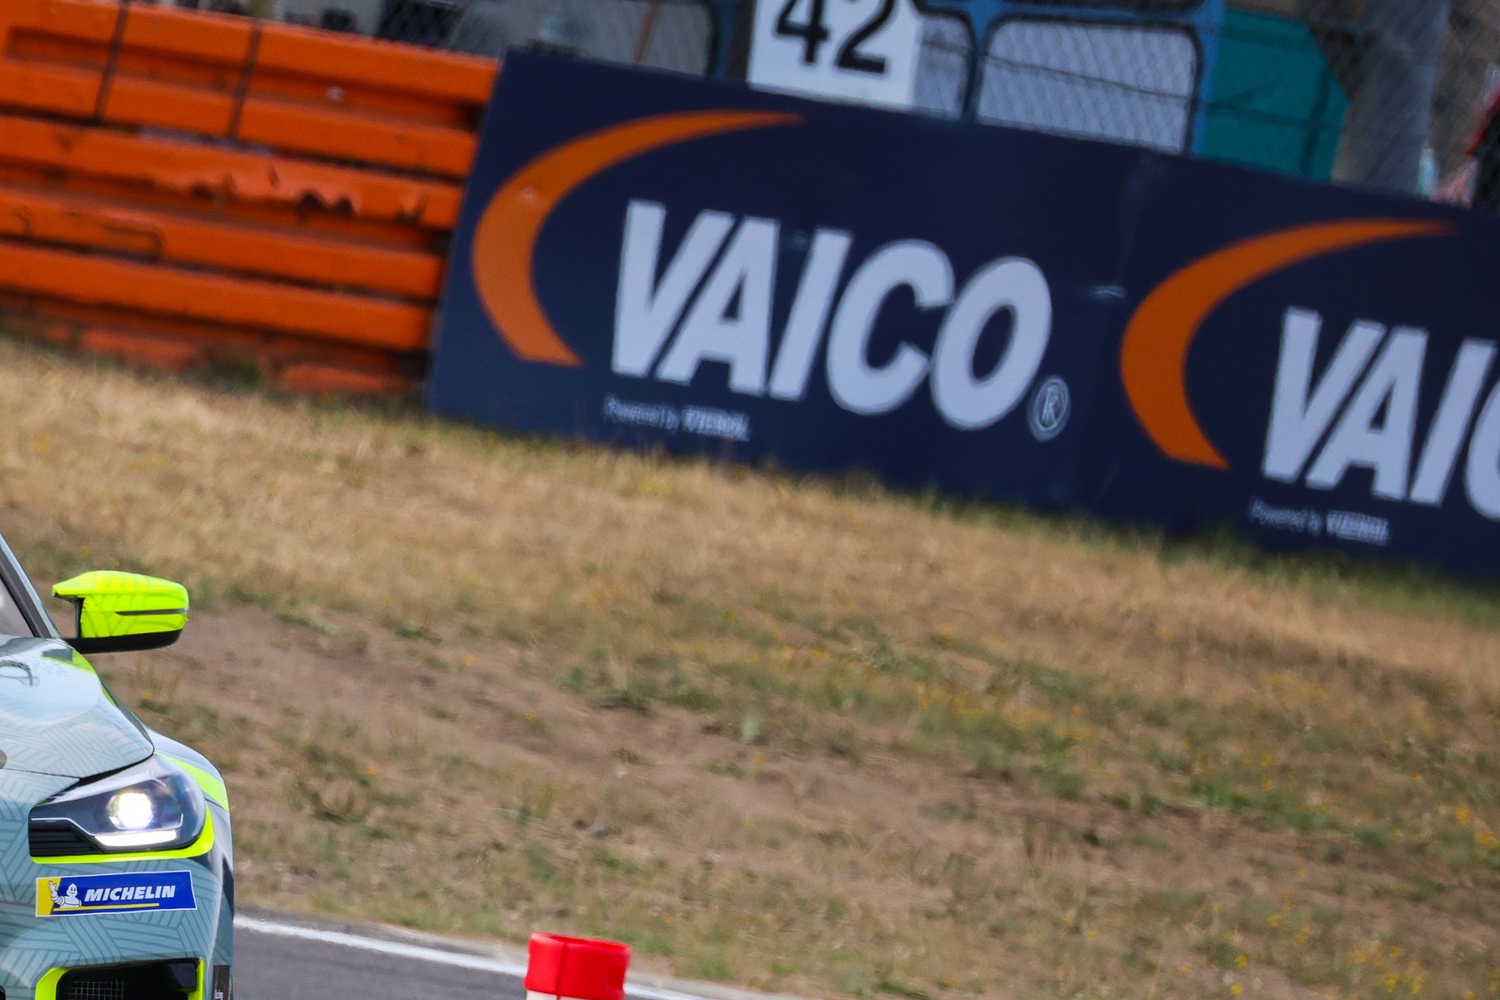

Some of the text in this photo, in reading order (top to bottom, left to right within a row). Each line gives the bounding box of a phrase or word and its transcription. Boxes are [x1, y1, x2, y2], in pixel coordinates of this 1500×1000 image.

[774, 0, 887, 73] 42
[612, 199, 1052, 431] VAICO
[1262, 307, 1500, 521] VAI
[84, 884, 176, 902] MICHELIN
